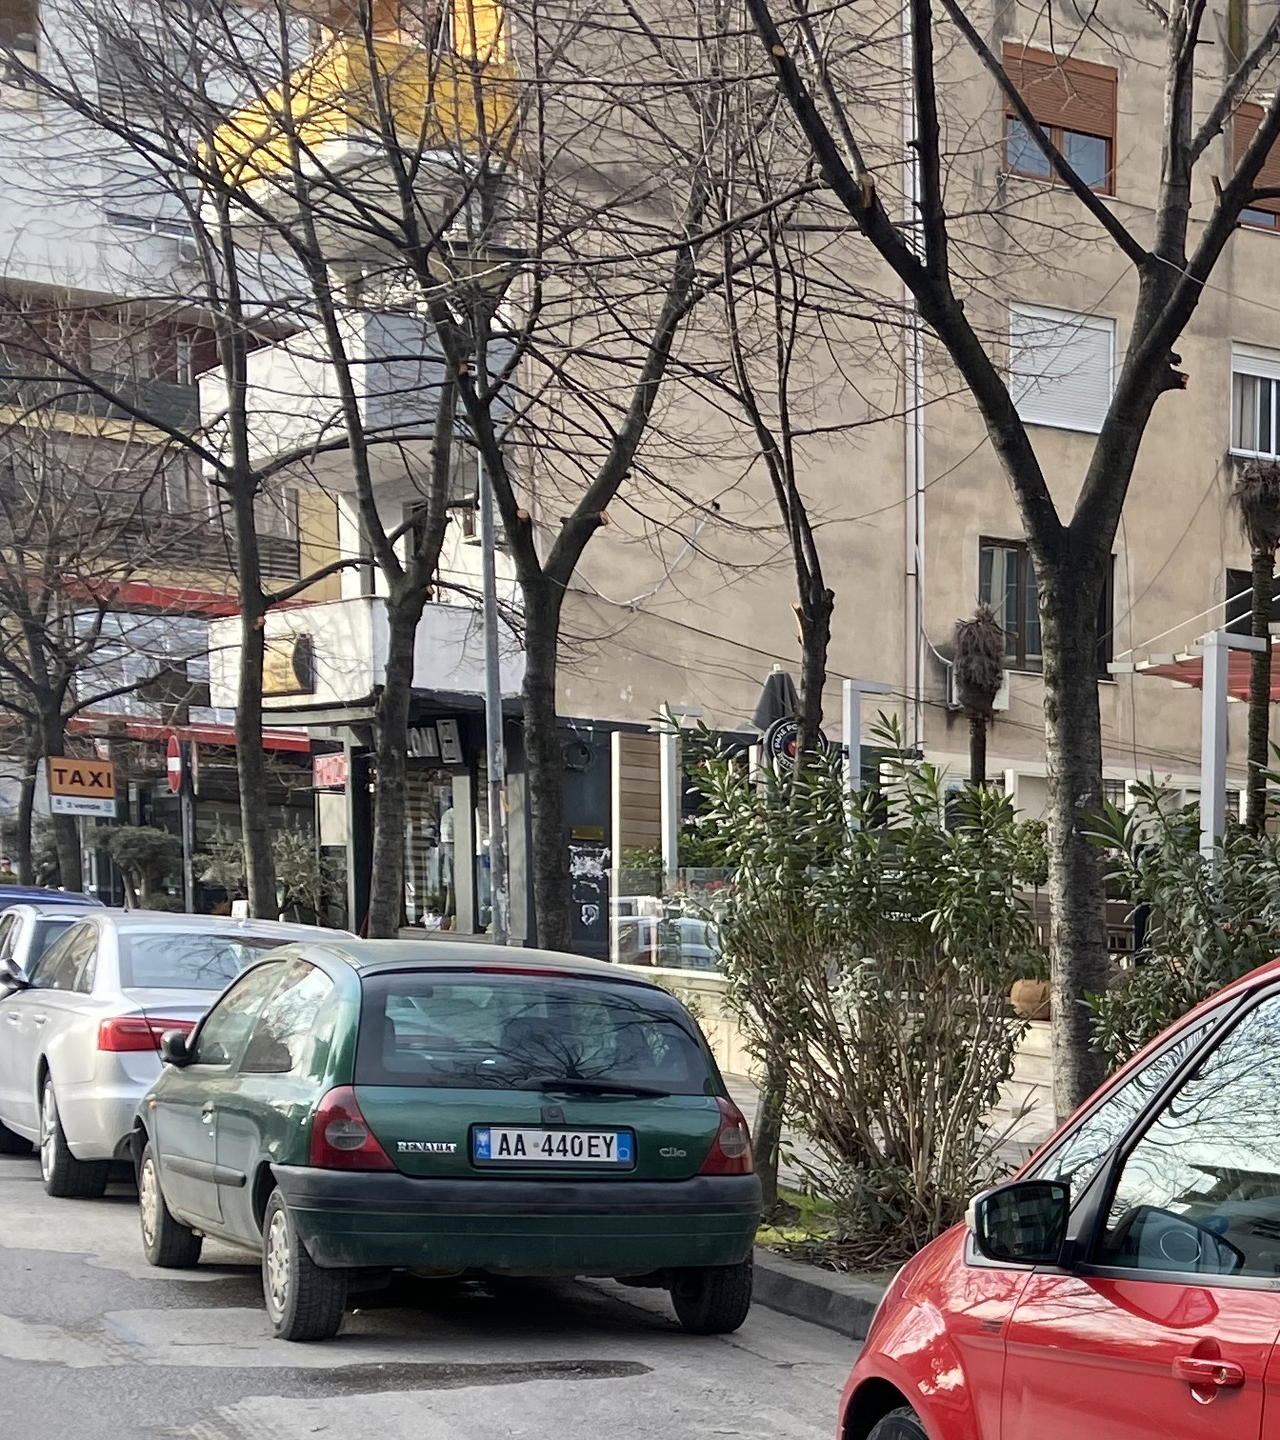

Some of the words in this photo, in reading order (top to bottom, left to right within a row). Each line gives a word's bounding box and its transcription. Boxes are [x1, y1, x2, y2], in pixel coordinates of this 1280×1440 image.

[53, 768, 112, 788] TAXI
[396, 1141, 457, 1154] RENAULT
[497, 1133, 526, 1156] AA
[540, 1134, 615, 1159] 440EY
